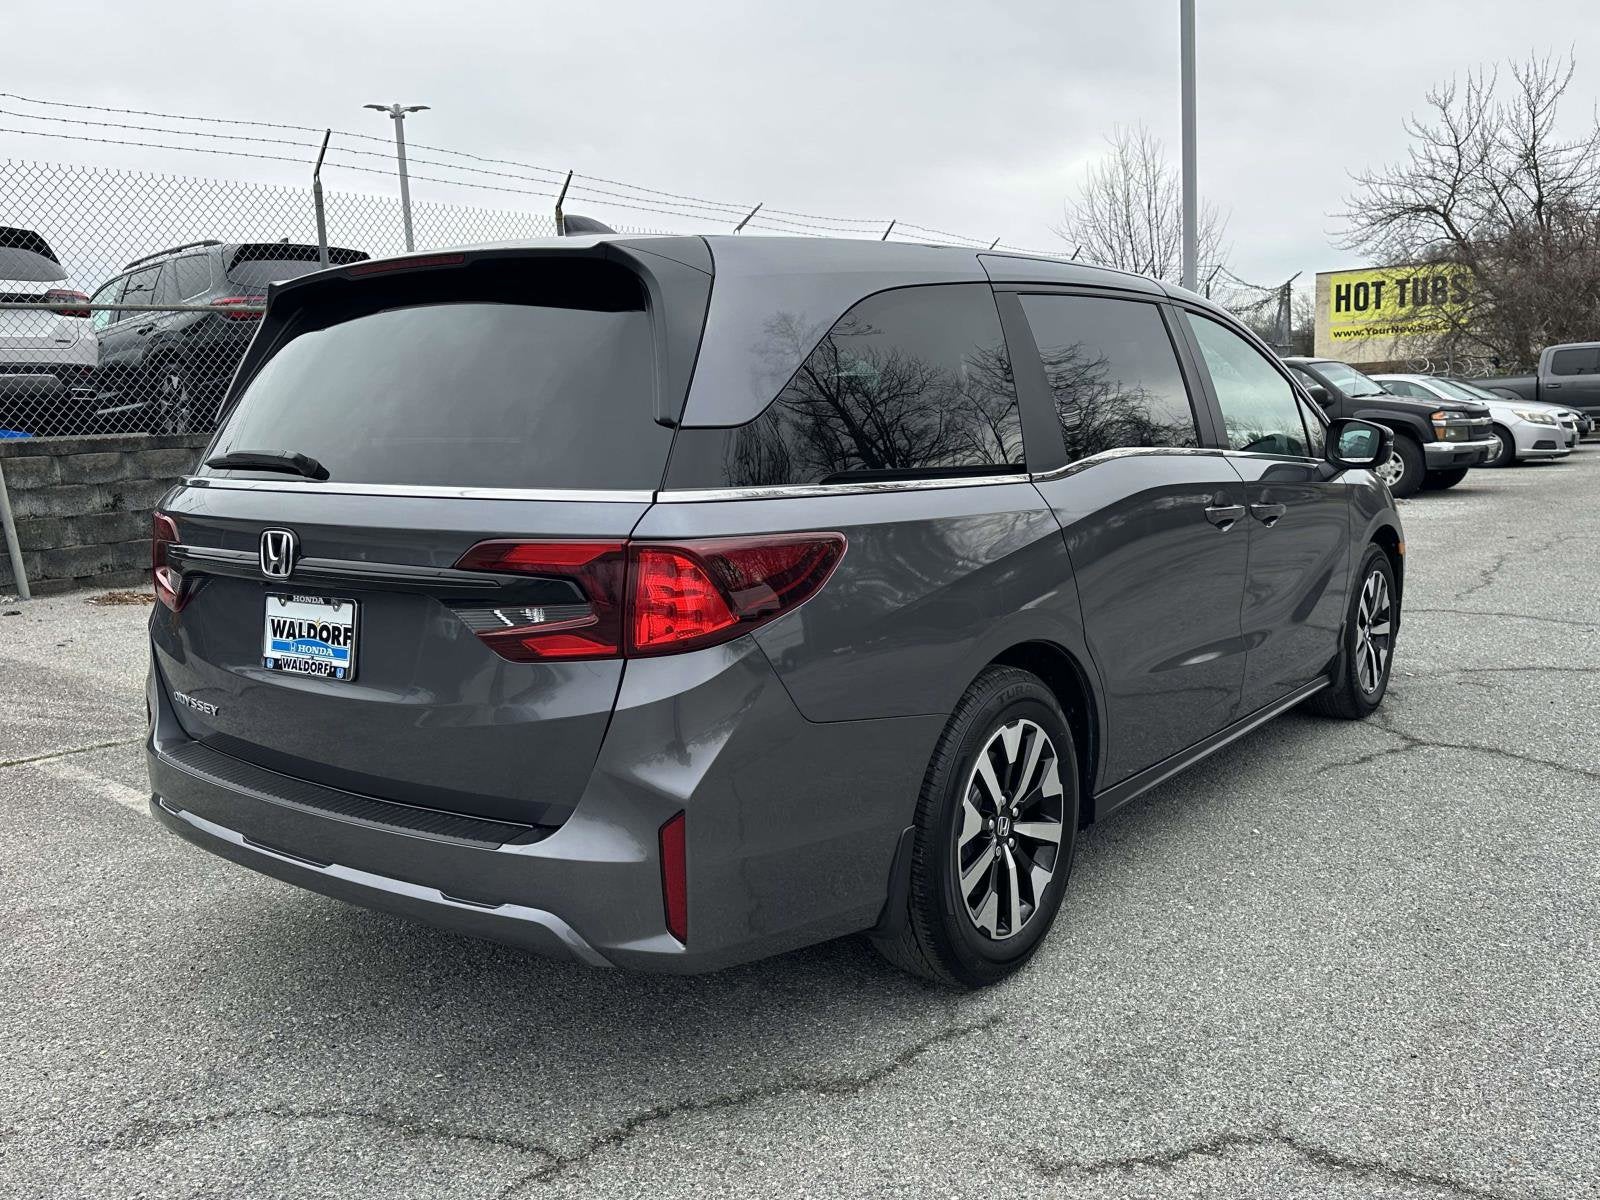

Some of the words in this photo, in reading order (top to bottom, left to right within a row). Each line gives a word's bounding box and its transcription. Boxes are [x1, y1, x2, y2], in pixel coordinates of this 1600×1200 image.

[1335, 281, 1386, 313] HOT
[1396, 273, 1468, 308] TUBS
[293, 595, 325, 605] HONDA
[270, 618, 352, 647] WALDORF
[298, 644, 334, 656] HONDA
[282, 657, 330, 675] WALDORF
[174, 691, 219, 716] ODYSSEY
